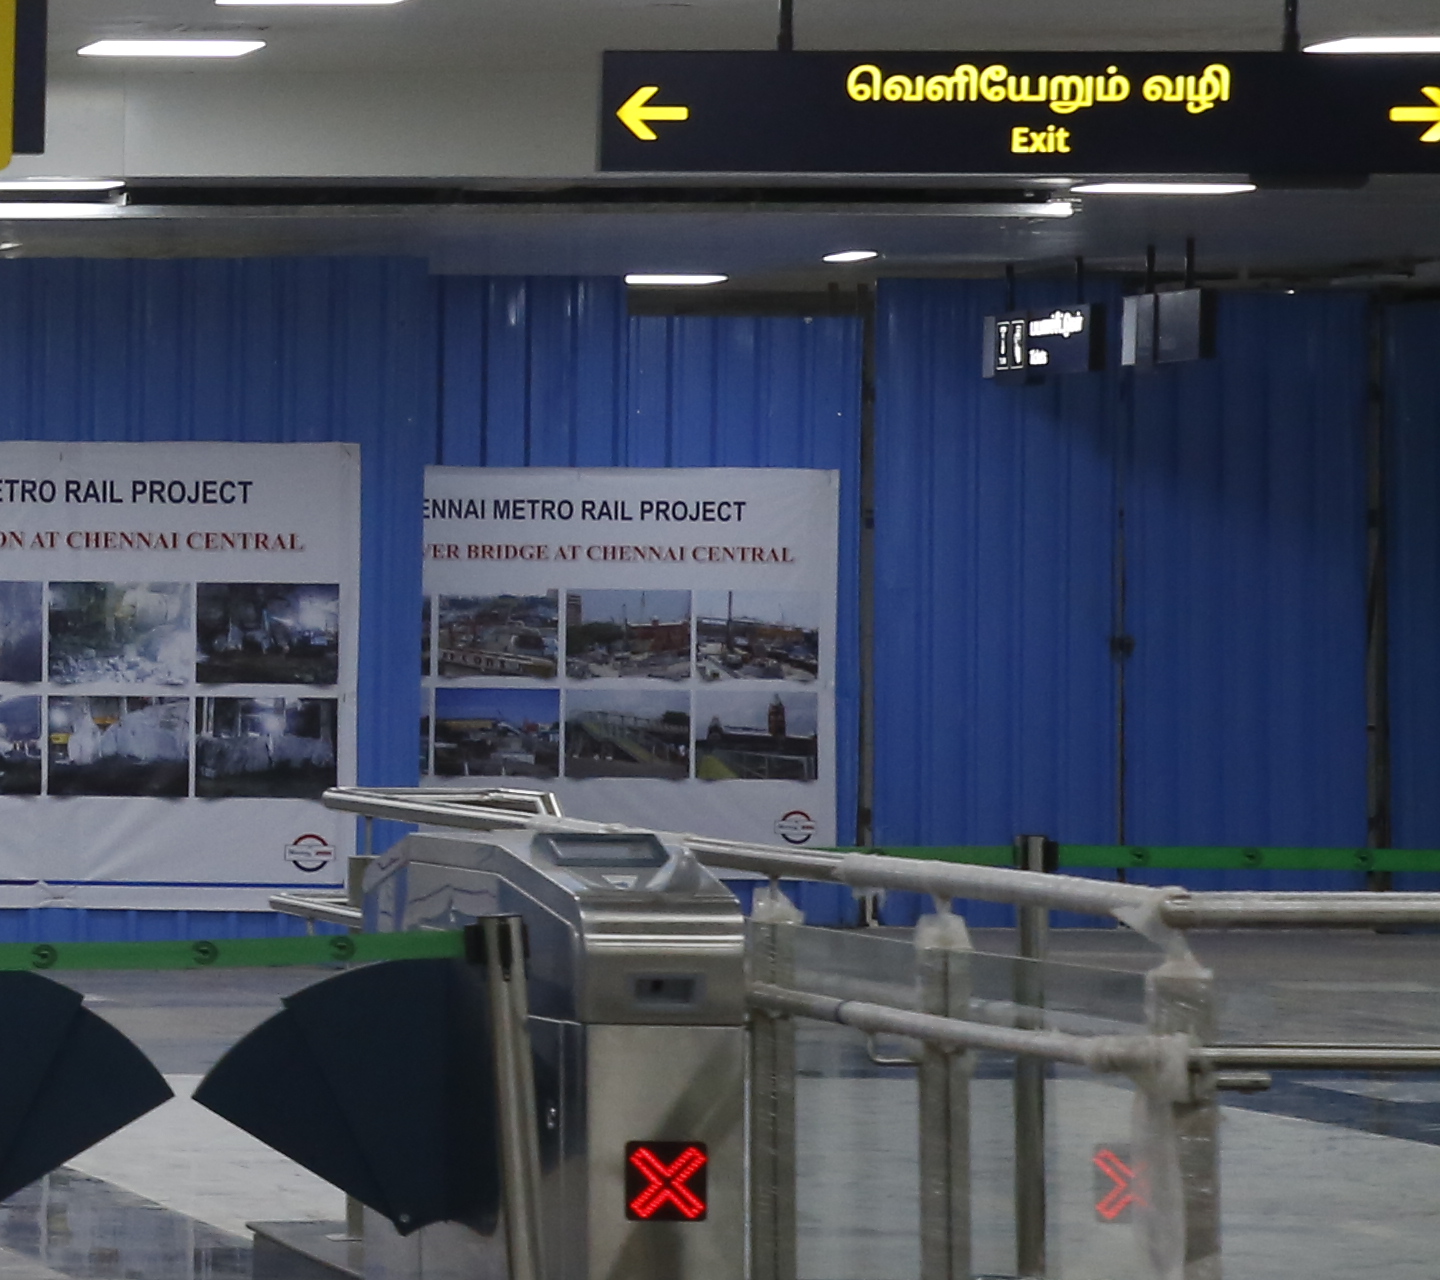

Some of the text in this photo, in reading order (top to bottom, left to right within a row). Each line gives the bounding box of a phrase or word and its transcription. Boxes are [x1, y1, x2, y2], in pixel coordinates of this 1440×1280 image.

[846, 64, 1231, 114] வெளியேறும் வழி
[1010, 126, 1071, 154] Exit
[65, 480, 123, 503] RAIL
[132, 481, 253, 505] PROJECT
[423, 499, 747, 522] ENNAI METRO RAIL PROJECT
[32, 531, 60, 549] AT
[66, 531, 179, 550] CHENNAI
[186, 532, 305, 551] CENTRAL
[467, 543, 549, 560] BRIDGE
[555, 544, 582, 561] AT
[586, 545, 686, 562] CHENNAI
[692, 546, 795, 563] CENTRAL
